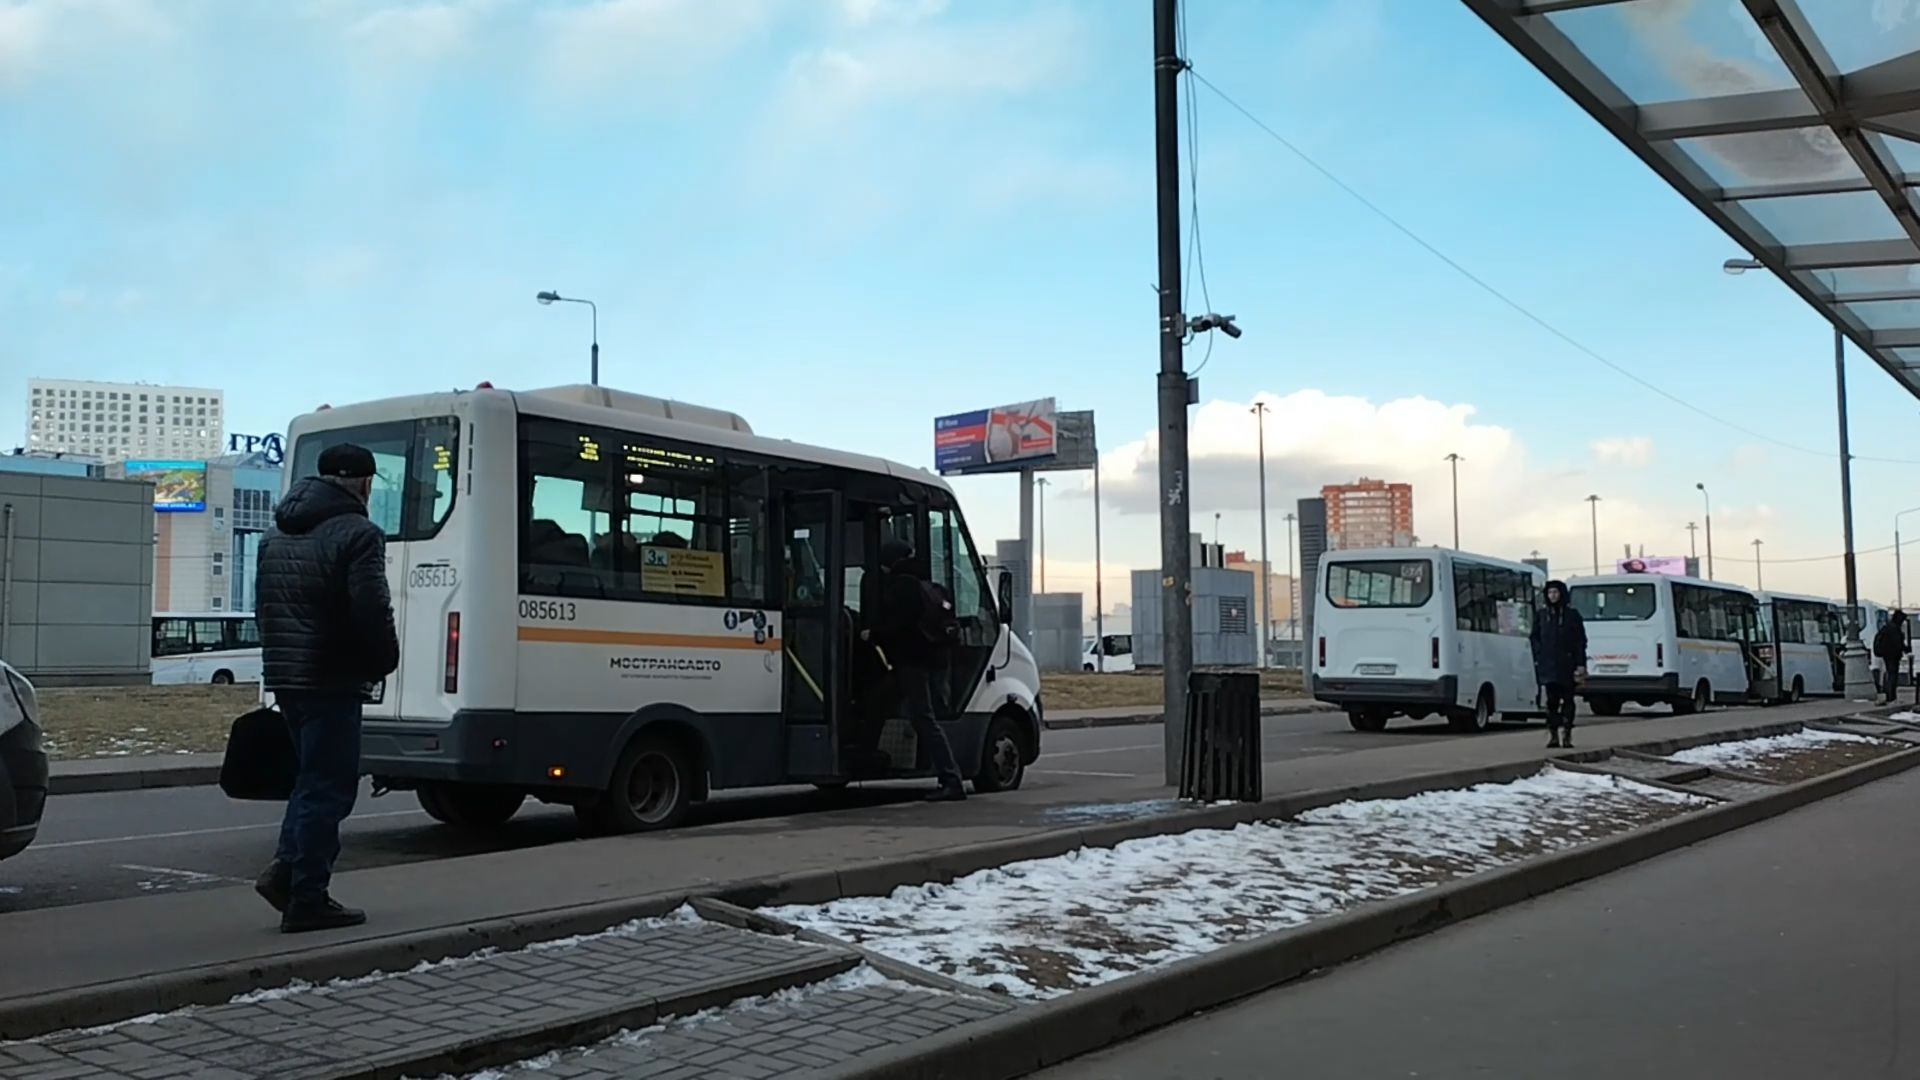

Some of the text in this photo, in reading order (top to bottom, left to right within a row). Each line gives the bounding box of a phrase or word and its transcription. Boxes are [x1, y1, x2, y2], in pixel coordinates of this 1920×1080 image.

[409, 568, 457, 588] 085613
[518, 600, 577, 621] 085613
[610, 657, 721, 671] МОСТРАНСАВТО
